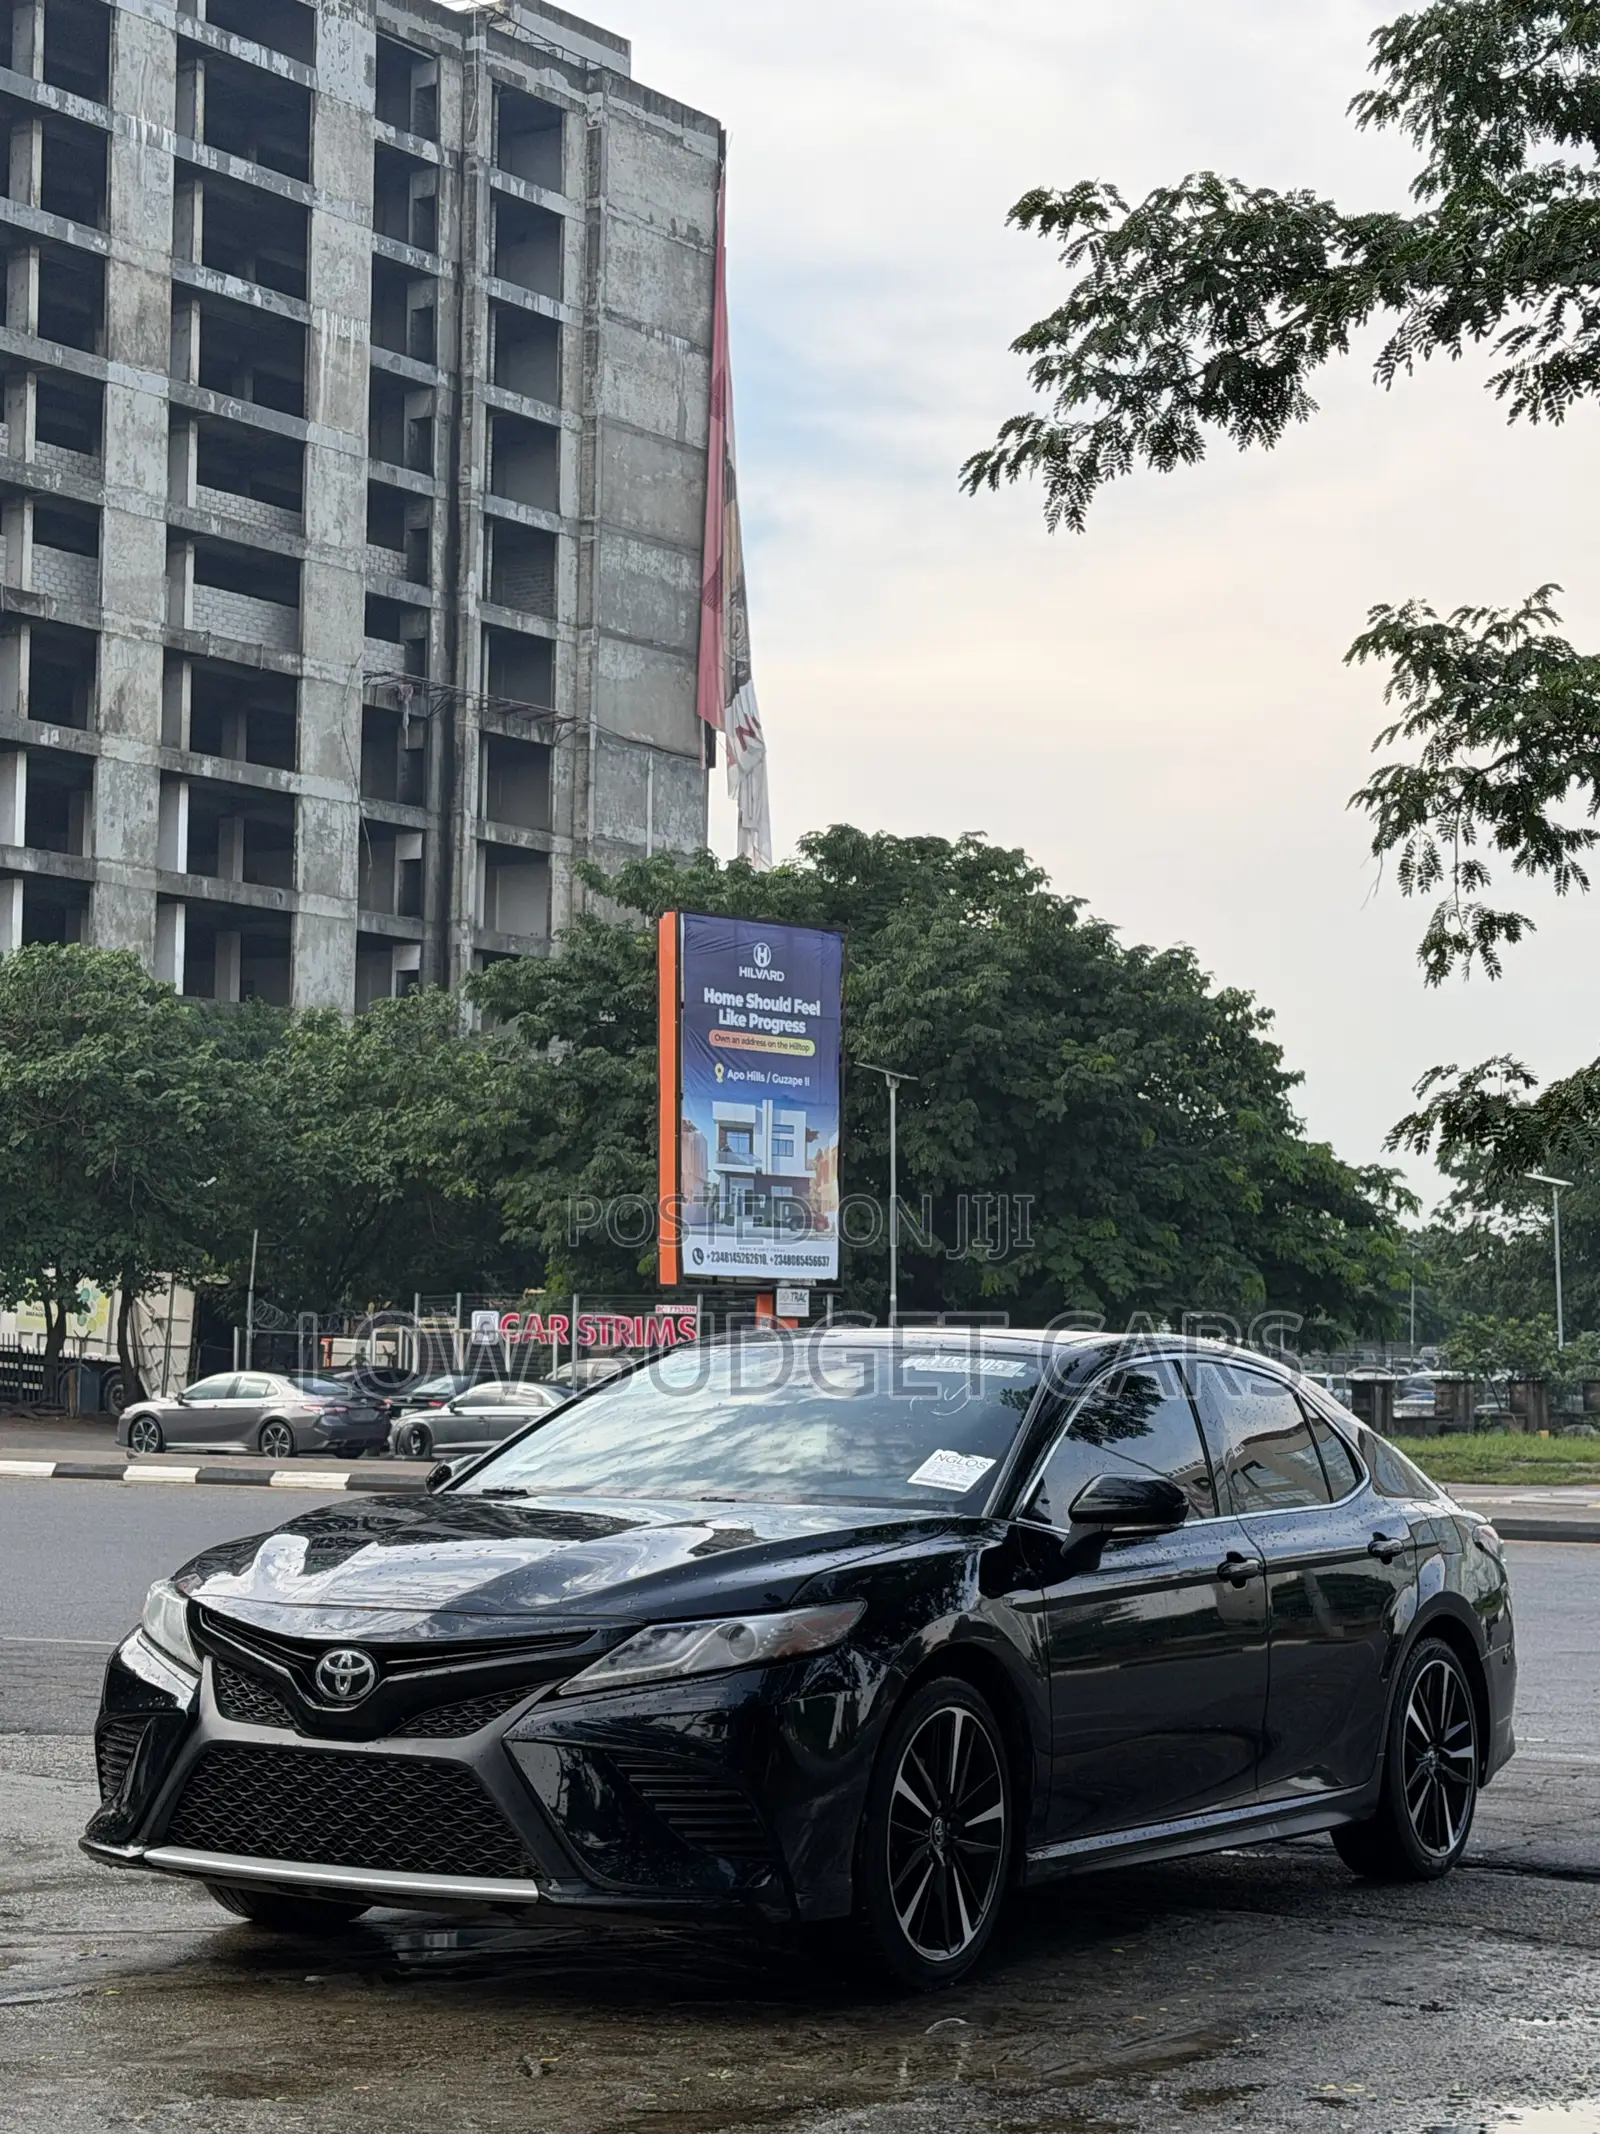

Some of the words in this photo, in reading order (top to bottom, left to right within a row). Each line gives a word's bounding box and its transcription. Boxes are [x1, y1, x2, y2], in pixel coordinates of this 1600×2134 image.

[738, 966, 785, 982] HILVARD
[703, 987, 744, 1007] Home
[746, 993, 791, 1013] Should
[794, 999, 821, 1016] Feel
[718, 1008, 747, 1027] Like
[749, 1013, 806, 1035] Progress
[714, 1033, 731, 1044] Own
[732, 1036, 741, 1045] an
[741, 1036, 766, 1048] address
[766, 1040, 777, 1048] on
[777, 1039, 789, 1049] the
[789, 1040, 810, 1053] Hilltop
[727, 1069, 745, 1083] Apo
[746, 1070, 766, 1083] Hills
[772, 1073, 802, 1088] Guzape
[500, 1312, 570, 1345] CAR
[577, 1315, 698, 1348] STRIMS
